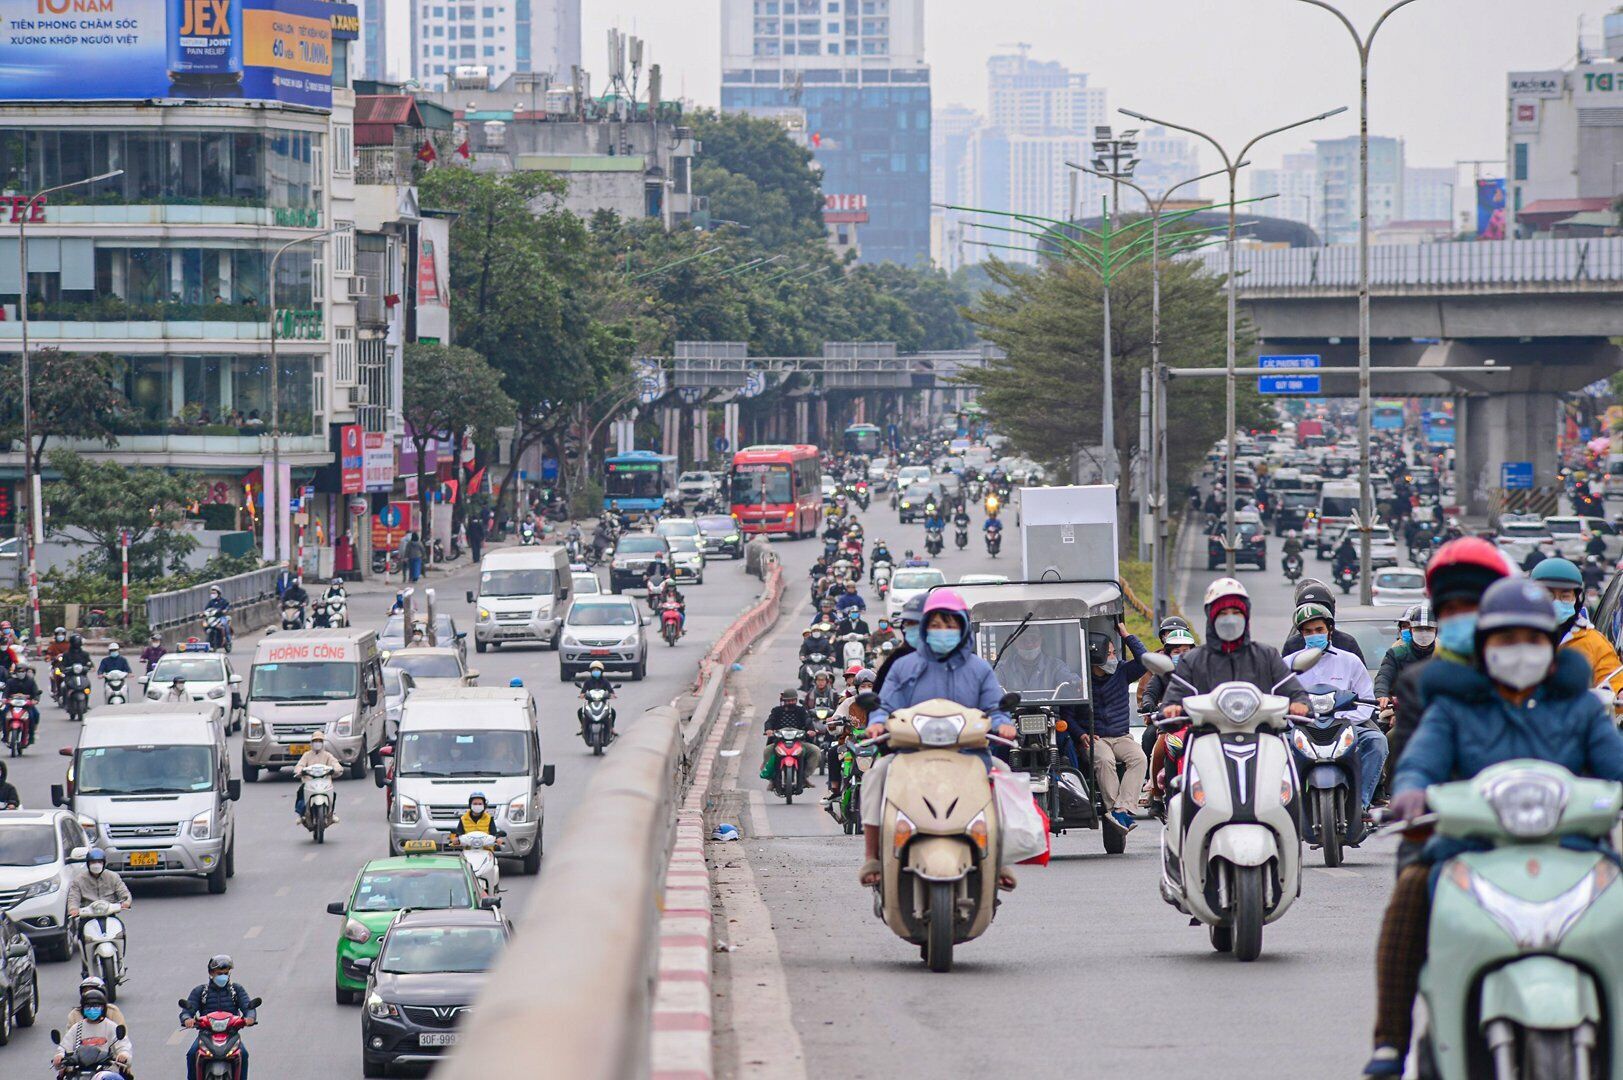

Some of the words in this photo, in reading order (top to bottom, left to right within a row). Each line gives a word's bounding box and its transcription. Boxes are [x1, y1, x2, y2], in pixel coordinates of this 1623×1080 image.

[180, 0, 231, 35] JEX
[11, 19, 35, 29] TIÊN
[38, 20, 77, 30] PHONG
[115, 18, 138, 29] SÓC
[11, 35, 47, 45] XƯƠNG
[50, 34, 79, 45] KHỚP
[81, 34, 114, 44] NGƯỜI
[116, 34, 139, 46] VIỆT
[208, 39, 232, 47] JOINT
[187, 47, 204, 55] PAIN
[204, 48, 226, 56] RELIEF
[273, 38, 284, 57] 60
[269, 645, 309, 662] HOÀNG
[313, 642, 346, 660] CÔNG
